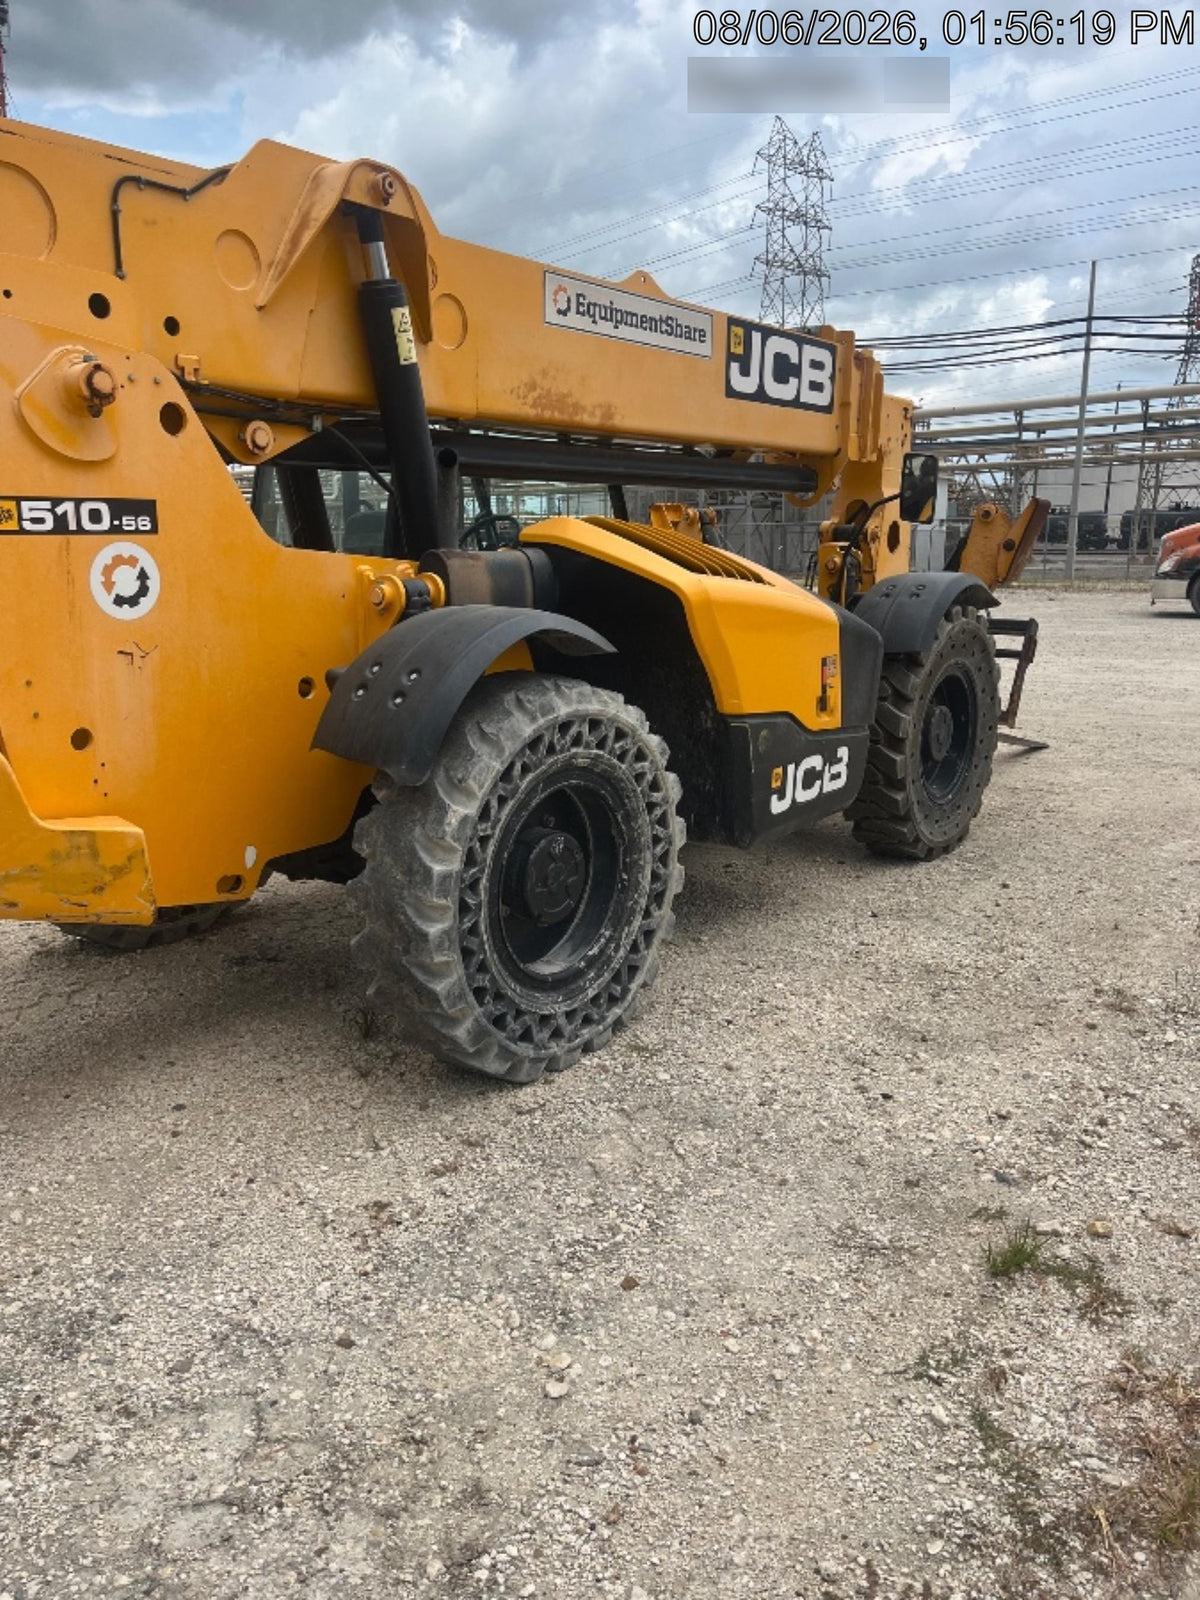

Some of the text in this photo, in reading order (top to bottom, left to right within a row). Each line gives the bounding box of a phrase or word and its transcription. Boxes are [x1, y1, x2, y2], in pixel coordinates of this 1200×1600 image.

[575, 292, 707, 344] EquipmentShare
[730, 330, 833, 406] JCB
[770, 746, 849, 815] JCB
